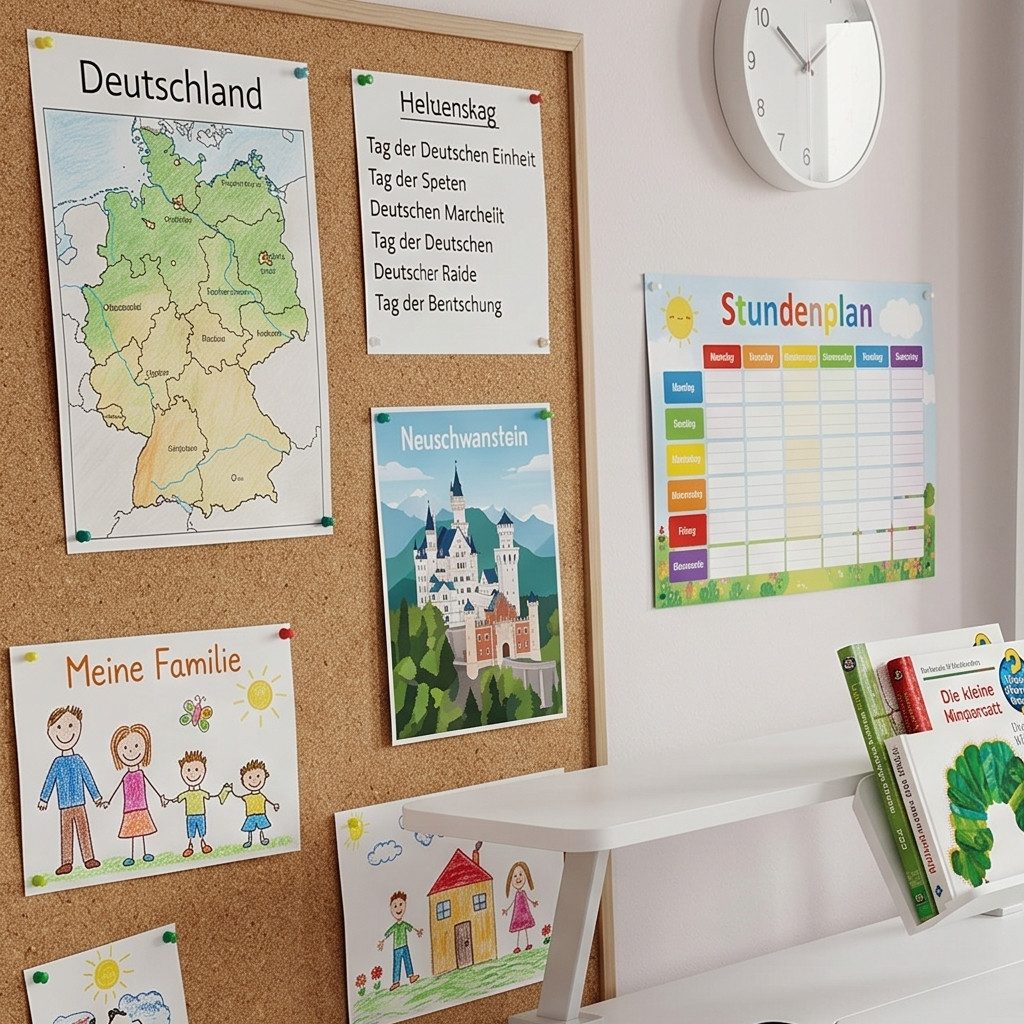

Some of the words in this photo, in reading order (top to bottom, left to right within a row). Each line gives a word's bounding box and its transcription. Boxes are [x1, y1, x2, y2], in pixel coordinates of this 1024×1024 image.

[754, 6, 770, 28] 10
[747, 50, 756, 70] 9
[79, 59, 262, 110] Deutschland
[757, 98, 765, 117] 8
[366, 136, 391, 160] Tag
[394, 138, 417, 157] der
[421, 141, 489, 163] Deutschen
[493, 147, 536, 167] Einheit
[777, 132, 786, 151] 7
[802, 147, 811, 166] 6
[368, 168, 392, 192] Tag
[396, 169, 418, 188] der
[422, 172, 467, 192] Speten
[370, 199, 441, 220] Deutschen
[371, 231, 396, 254] Tag
[400, 232, 422, 250] der
[425, 233, 493, 253] Deutschen
[374, 262, 439, 281] Deutscher
[442, 264, 477, 282] Raide
[375, 293, 399, 316] Tag
[403, 293, 424, 311] der
[721, 291, 873, 336] Stundenplan
[401, 425, 528, 451] Neuschwanstein
[66, 654, 144, 689] Meine
[155, 643, 242, 680] Familie
[940, 687, 960, 704] Die
[962, 684, 995, 701] kleine
